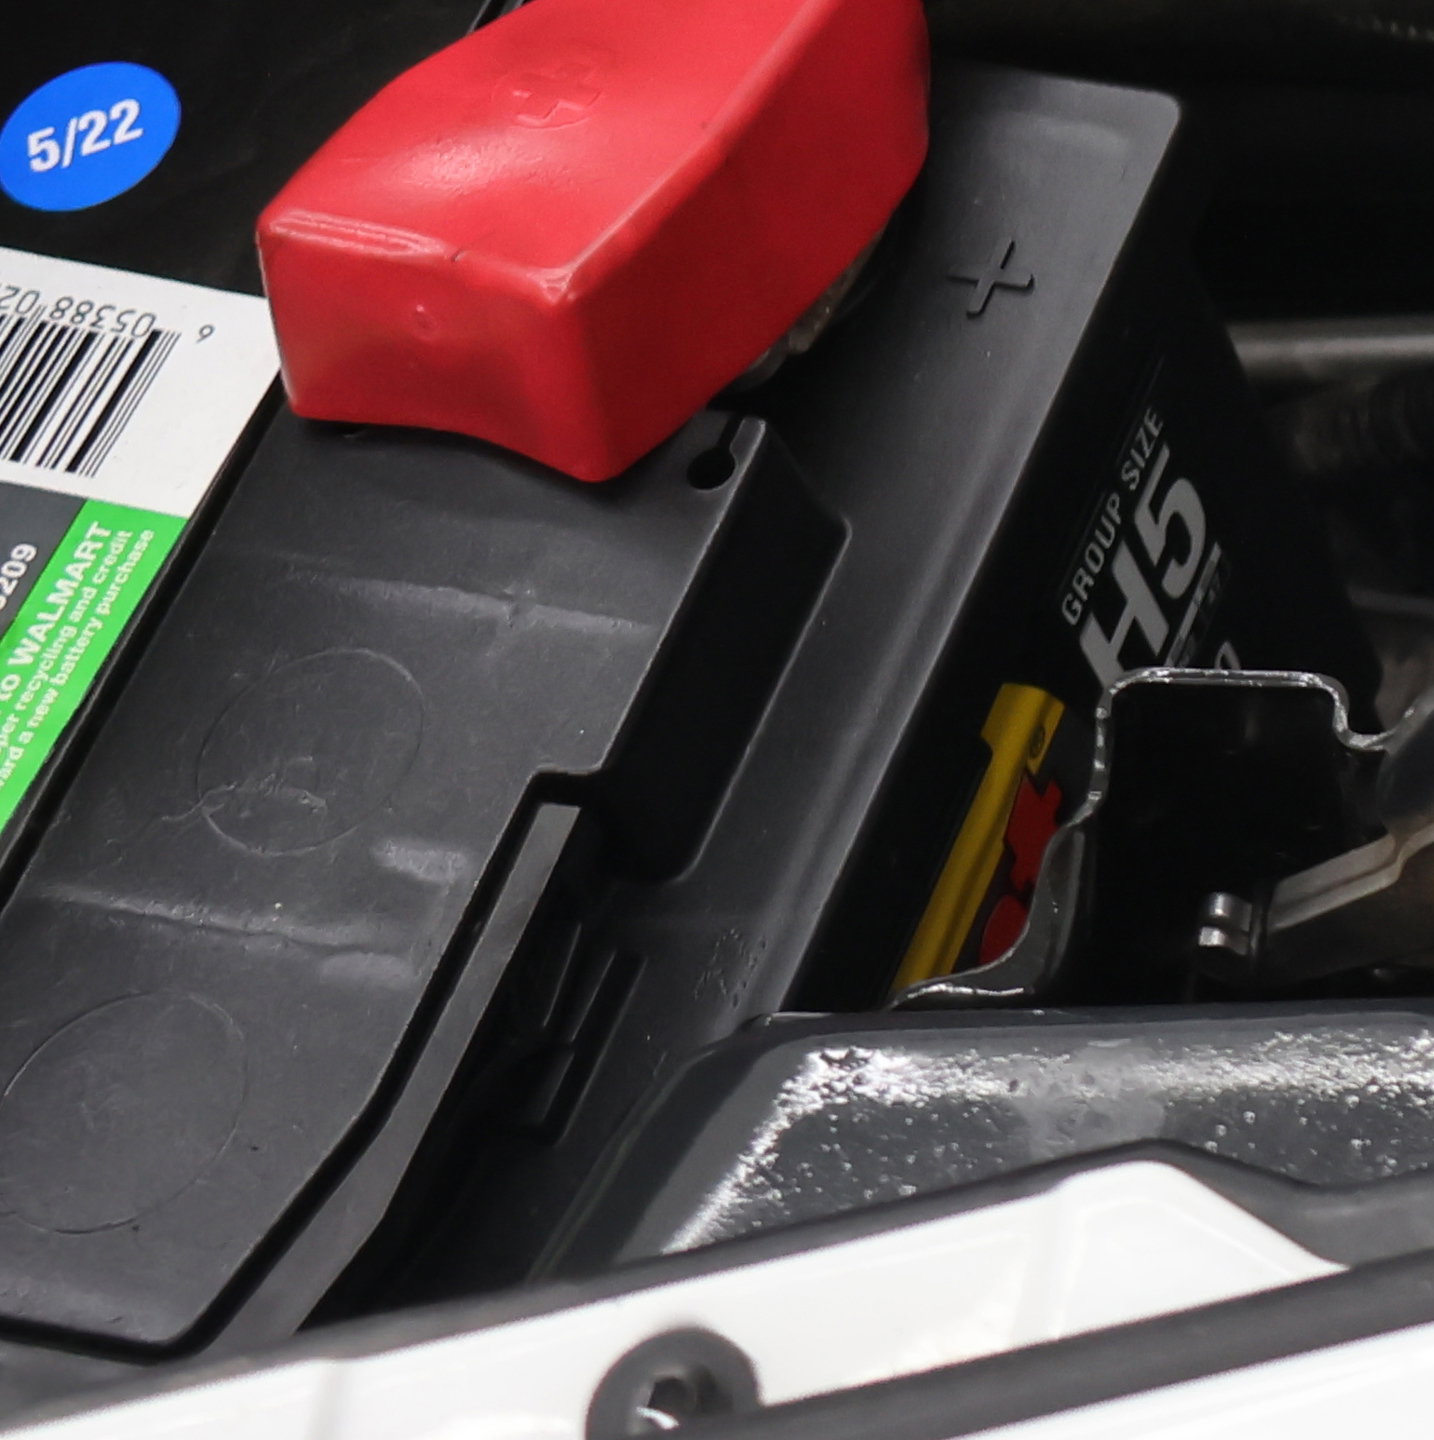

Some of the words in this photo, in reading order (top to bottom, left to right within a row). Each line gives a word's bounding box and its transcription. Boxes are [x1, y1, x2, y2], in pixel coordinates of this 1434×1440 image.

[27, 99, 144, 172] 5/22
[1061, 492, 1121, 626] GROUP
[1119, 406, 1164, 491] SIZE
[8, 521, 112, 667] WALMART
[94, 528, 155, 616] purchase
[1078, 442, 1207, 697] H5
[14, 624, 78, 711] recycling
[68, 586, 98, 622] and
[92, 530, 134, 585] credit
[49, 616, 104, 686] battery
[18, 730, 35, 745] a
[26, 687, 60, 729] new
